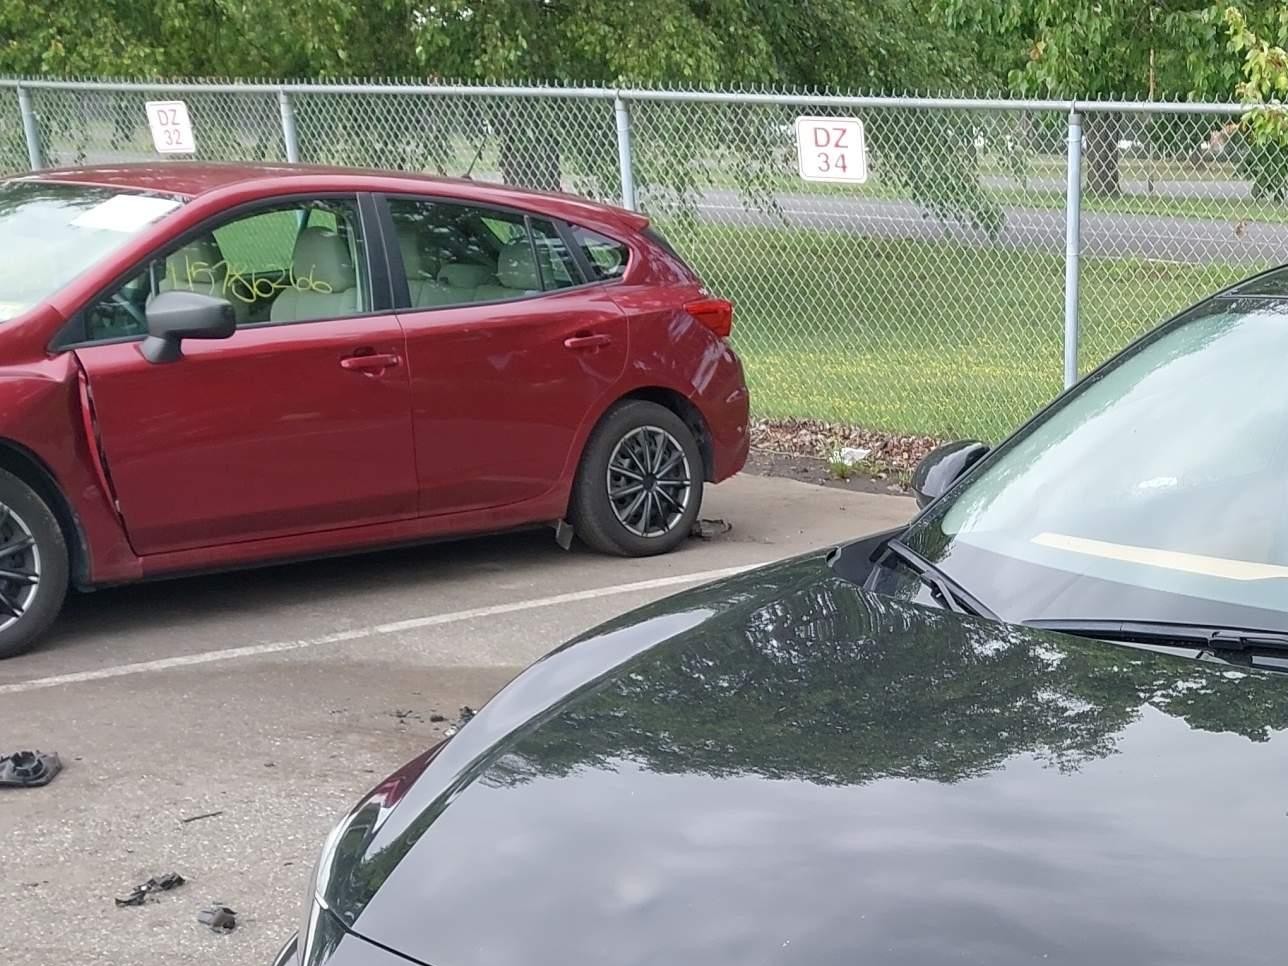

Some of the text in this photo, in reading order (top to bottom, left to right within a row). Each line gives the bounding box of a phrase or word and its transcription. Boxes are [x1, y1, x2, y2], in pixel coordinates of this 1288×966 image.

[157, 109, 181, 126] DZ
[164, 128, 182, 146] 32
[813, 127, 848, 149] DZ
[817, 152, 848, 173] 34
